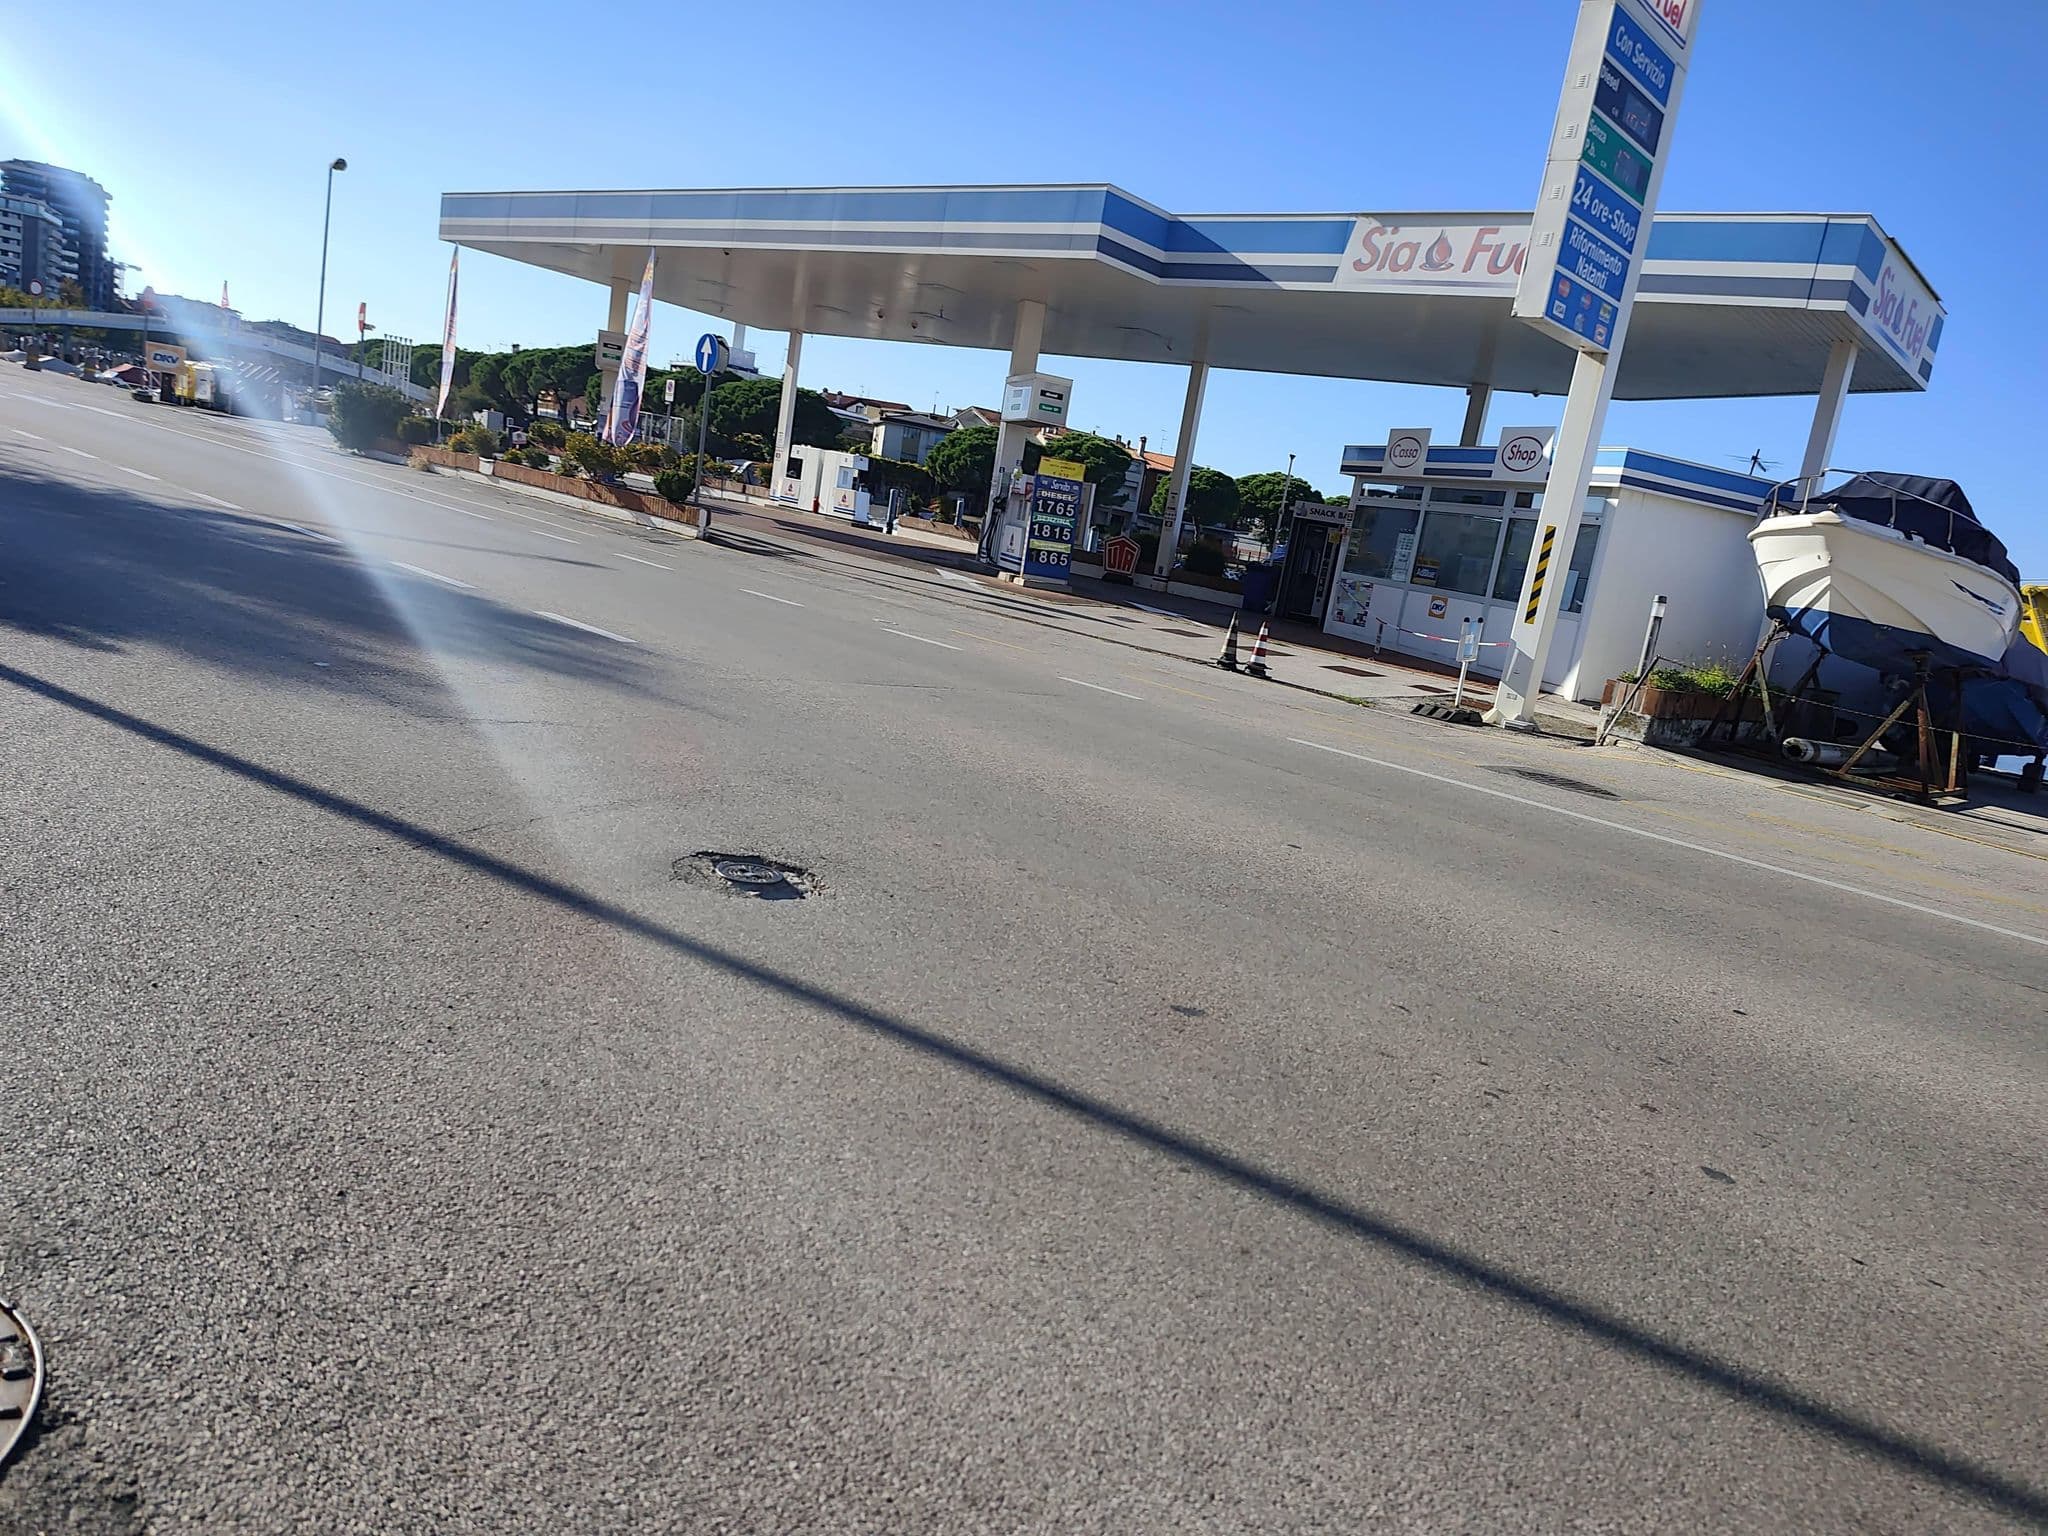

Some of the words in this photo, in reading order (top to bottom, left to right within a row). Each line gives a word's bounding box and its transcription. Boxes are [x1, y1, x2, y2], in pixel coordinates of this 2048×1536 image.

[1615, 26, 1633, 57] Con
[1632, 43, 1665, 89] Servizio
[1573, 178, 1593, 209] 24
[1591, 199, 1636, 244] ore-Shop
[1353, 226, 1421, 272] Sia
[1569, 226, 1622, 275] Rifornimento
[1576, 255, 1608, 289] Natanti
[1873, 266, 1898, 326] Sia
[1900, 299, 1931, 358] Fuel
[153, 353, 179, 363] DKV
[1393, 444, 1418, 458] Cassa
[1508, 445, 1536, 464] Shop
[1042, 490, 1074, 501] DIESEL
[1037, 500, 1075, 516] 1765
[1310, 508, 1336, 518] SNACK
[1033, 524, 1071, 540] 1815
[1432, 602, 1445, 611] DKV
